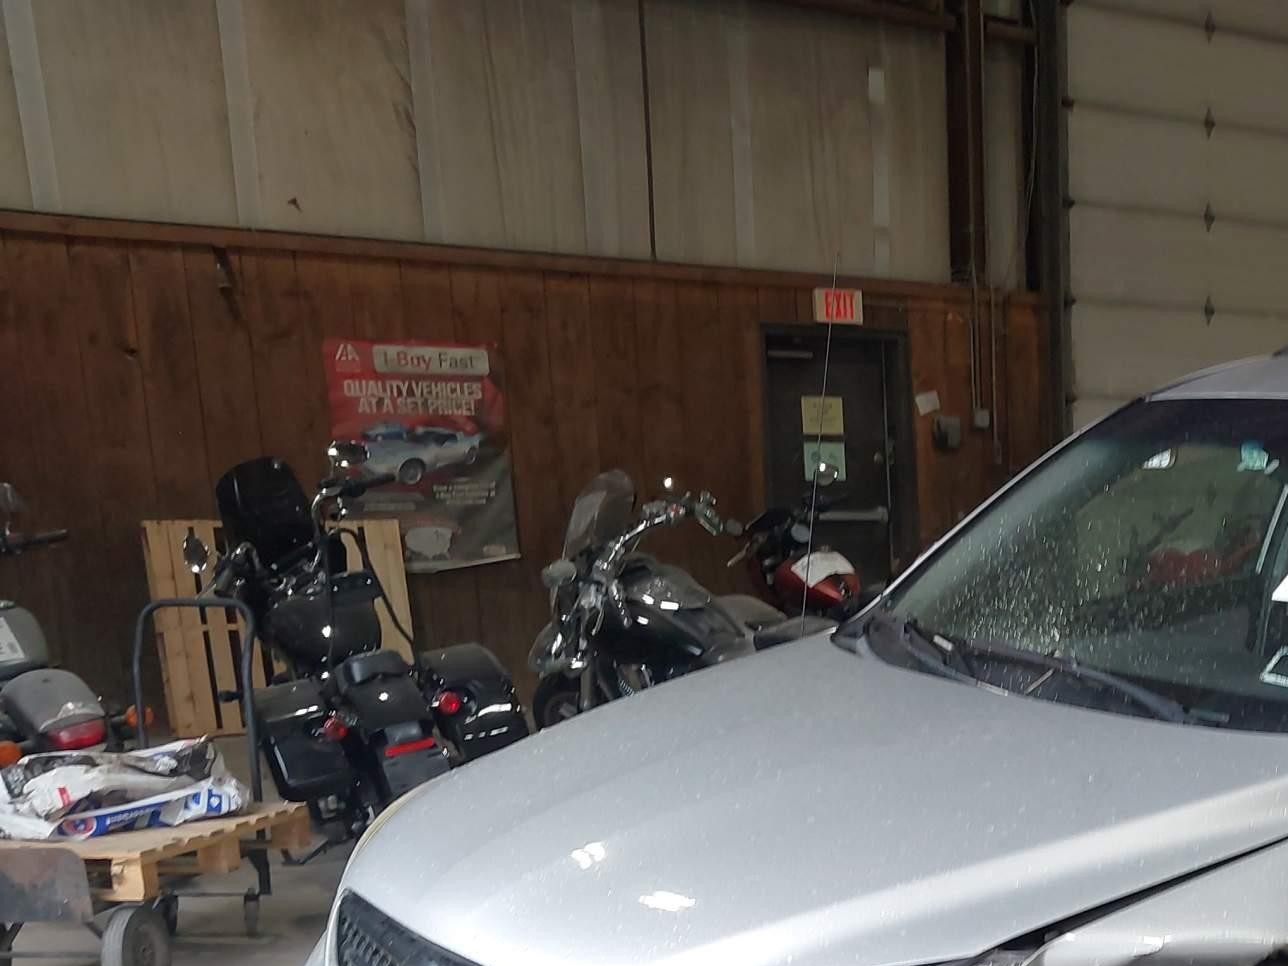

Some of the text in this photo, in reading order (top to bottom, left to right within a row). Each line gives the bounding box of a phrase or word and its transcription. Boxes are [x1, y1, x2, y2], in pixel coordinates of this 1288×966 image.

[824, 290, 854, 320] EXIT
[438, 353, 475, 369] Fast
[343, 380, 482, 400] QUALITY VEHICLES
[358, 399, 476, 416] AT A SET PRICE!
